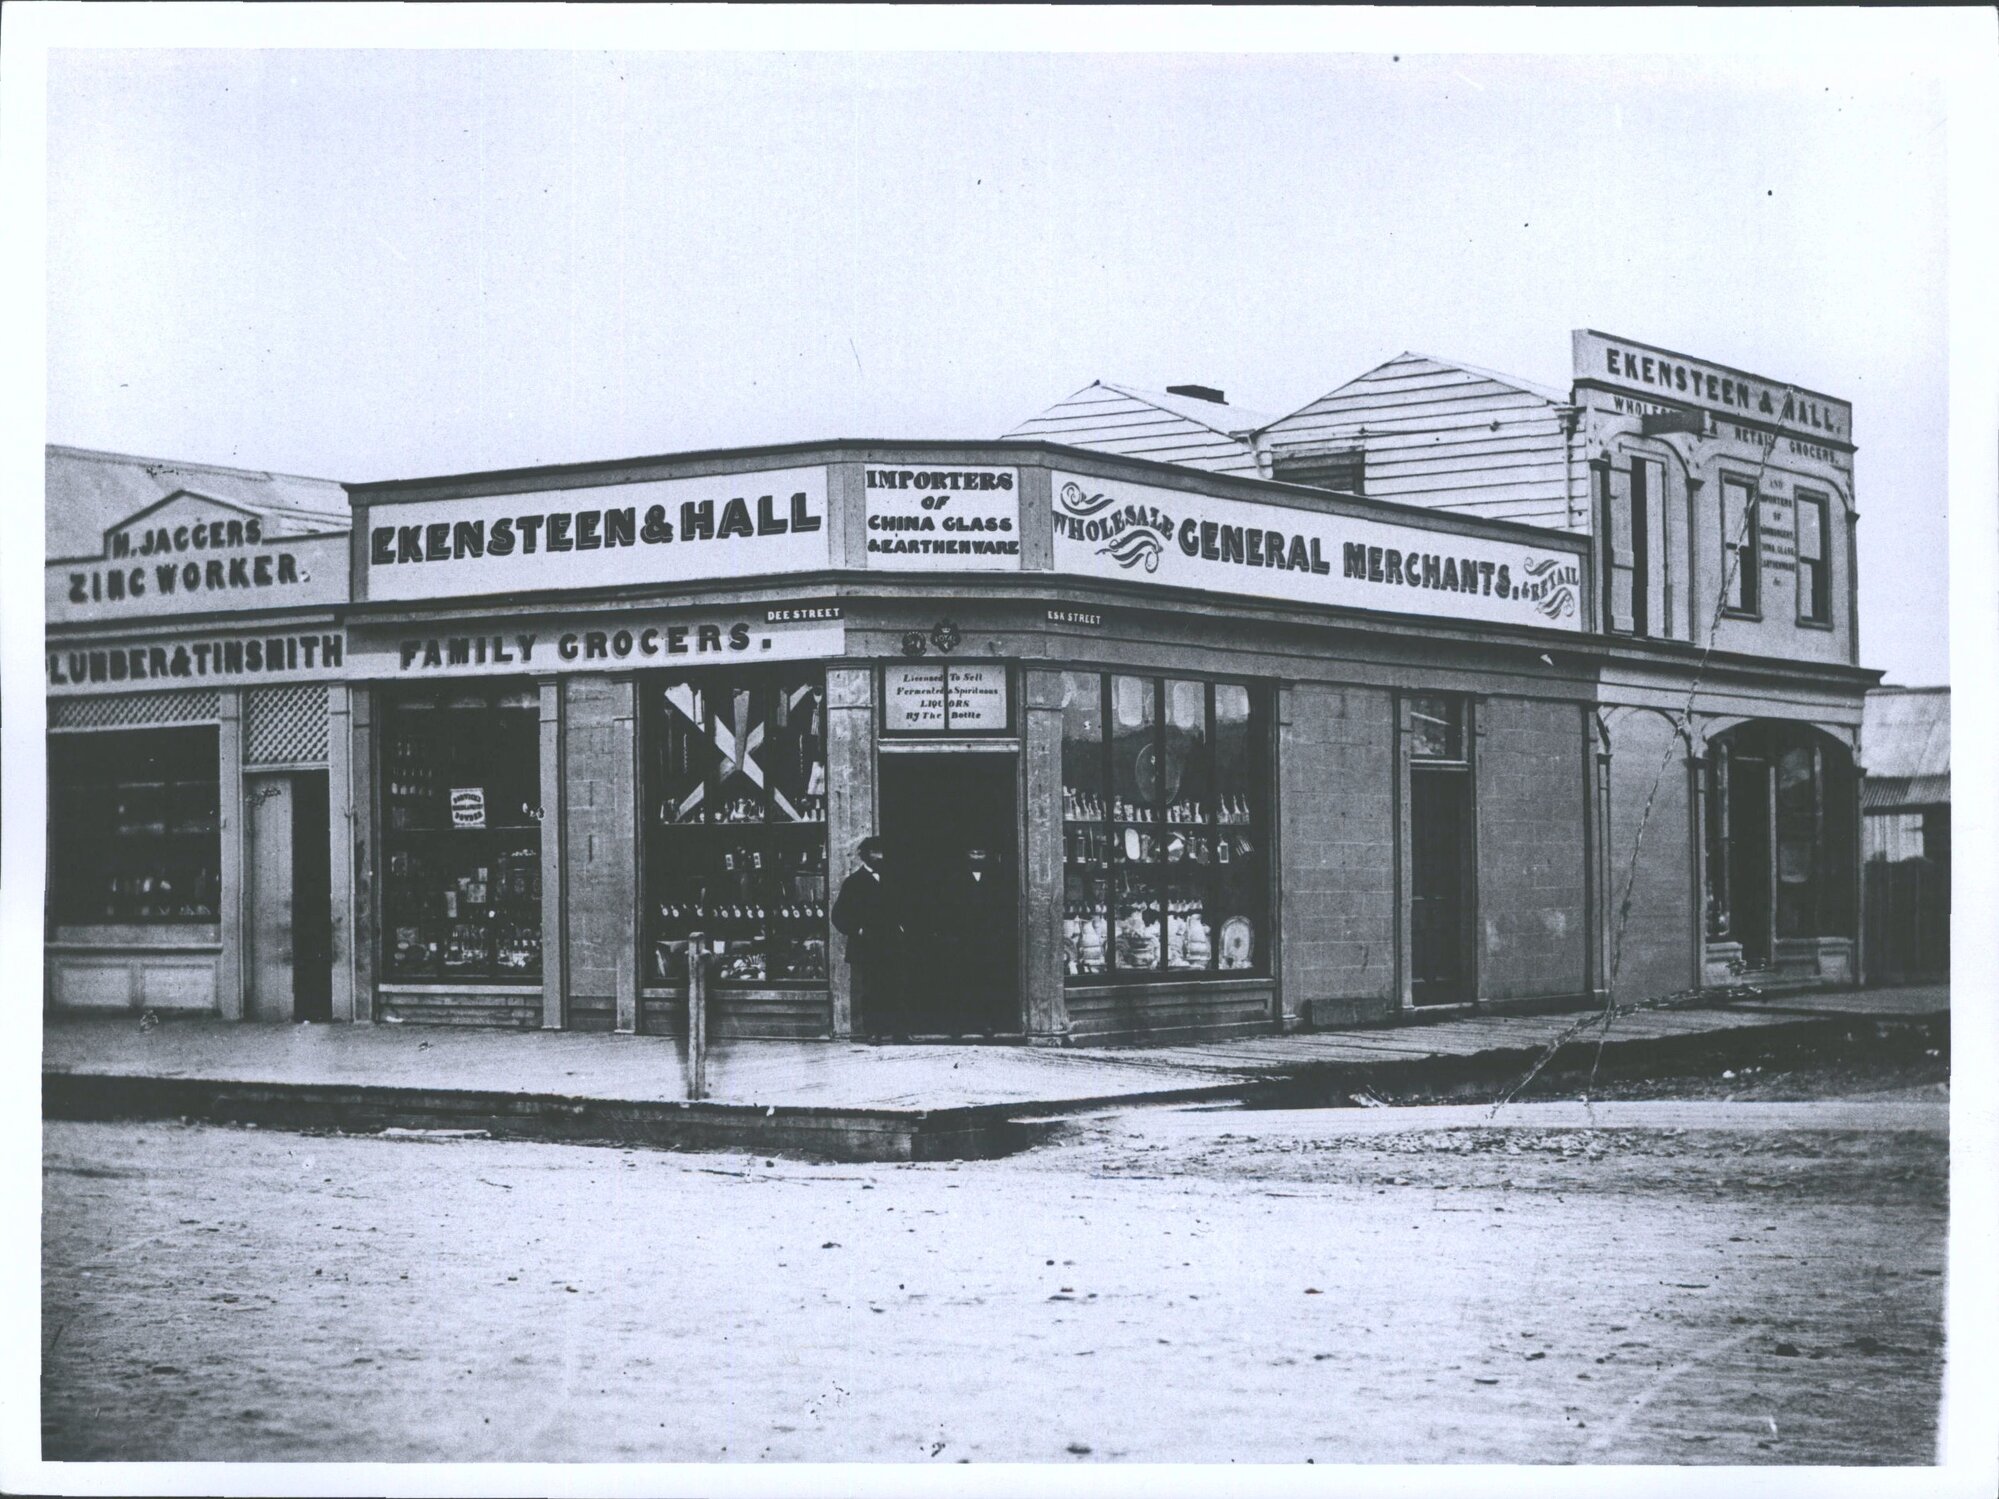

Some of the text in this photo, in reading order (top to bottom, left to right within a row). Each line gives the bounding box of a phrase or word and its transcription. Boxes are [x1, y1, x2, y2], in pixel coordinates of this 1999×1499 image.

[1607, 349, 1749, 409] EKENSTEEN
[1759, 390, 1774, 415] &
[866, 470, 1014, 491] IMPORTERS
[921, 495, 951, 511] OF
[868, 514, 1013, 532] CHINA GLASS
[1052, 505, 1175, 541] WHOLESALE
[1178, 518, 1331, 576] GENERAL
[1343, 542, 1520, 601] MERCHANTS.
[68, 567, 146, 603] ZINC
[767, 608, 840, 621] DEE STREET
[1047, 611, 1101, 625] ESK STREET
[400, 622, 772, 671] FAMILY GROCERS.
[950, 673, 961, 682] To
[963, 673, 983, 682] Sell
[922, 711, 942, 719] The
[951, 711, 982, 719] Bottle
